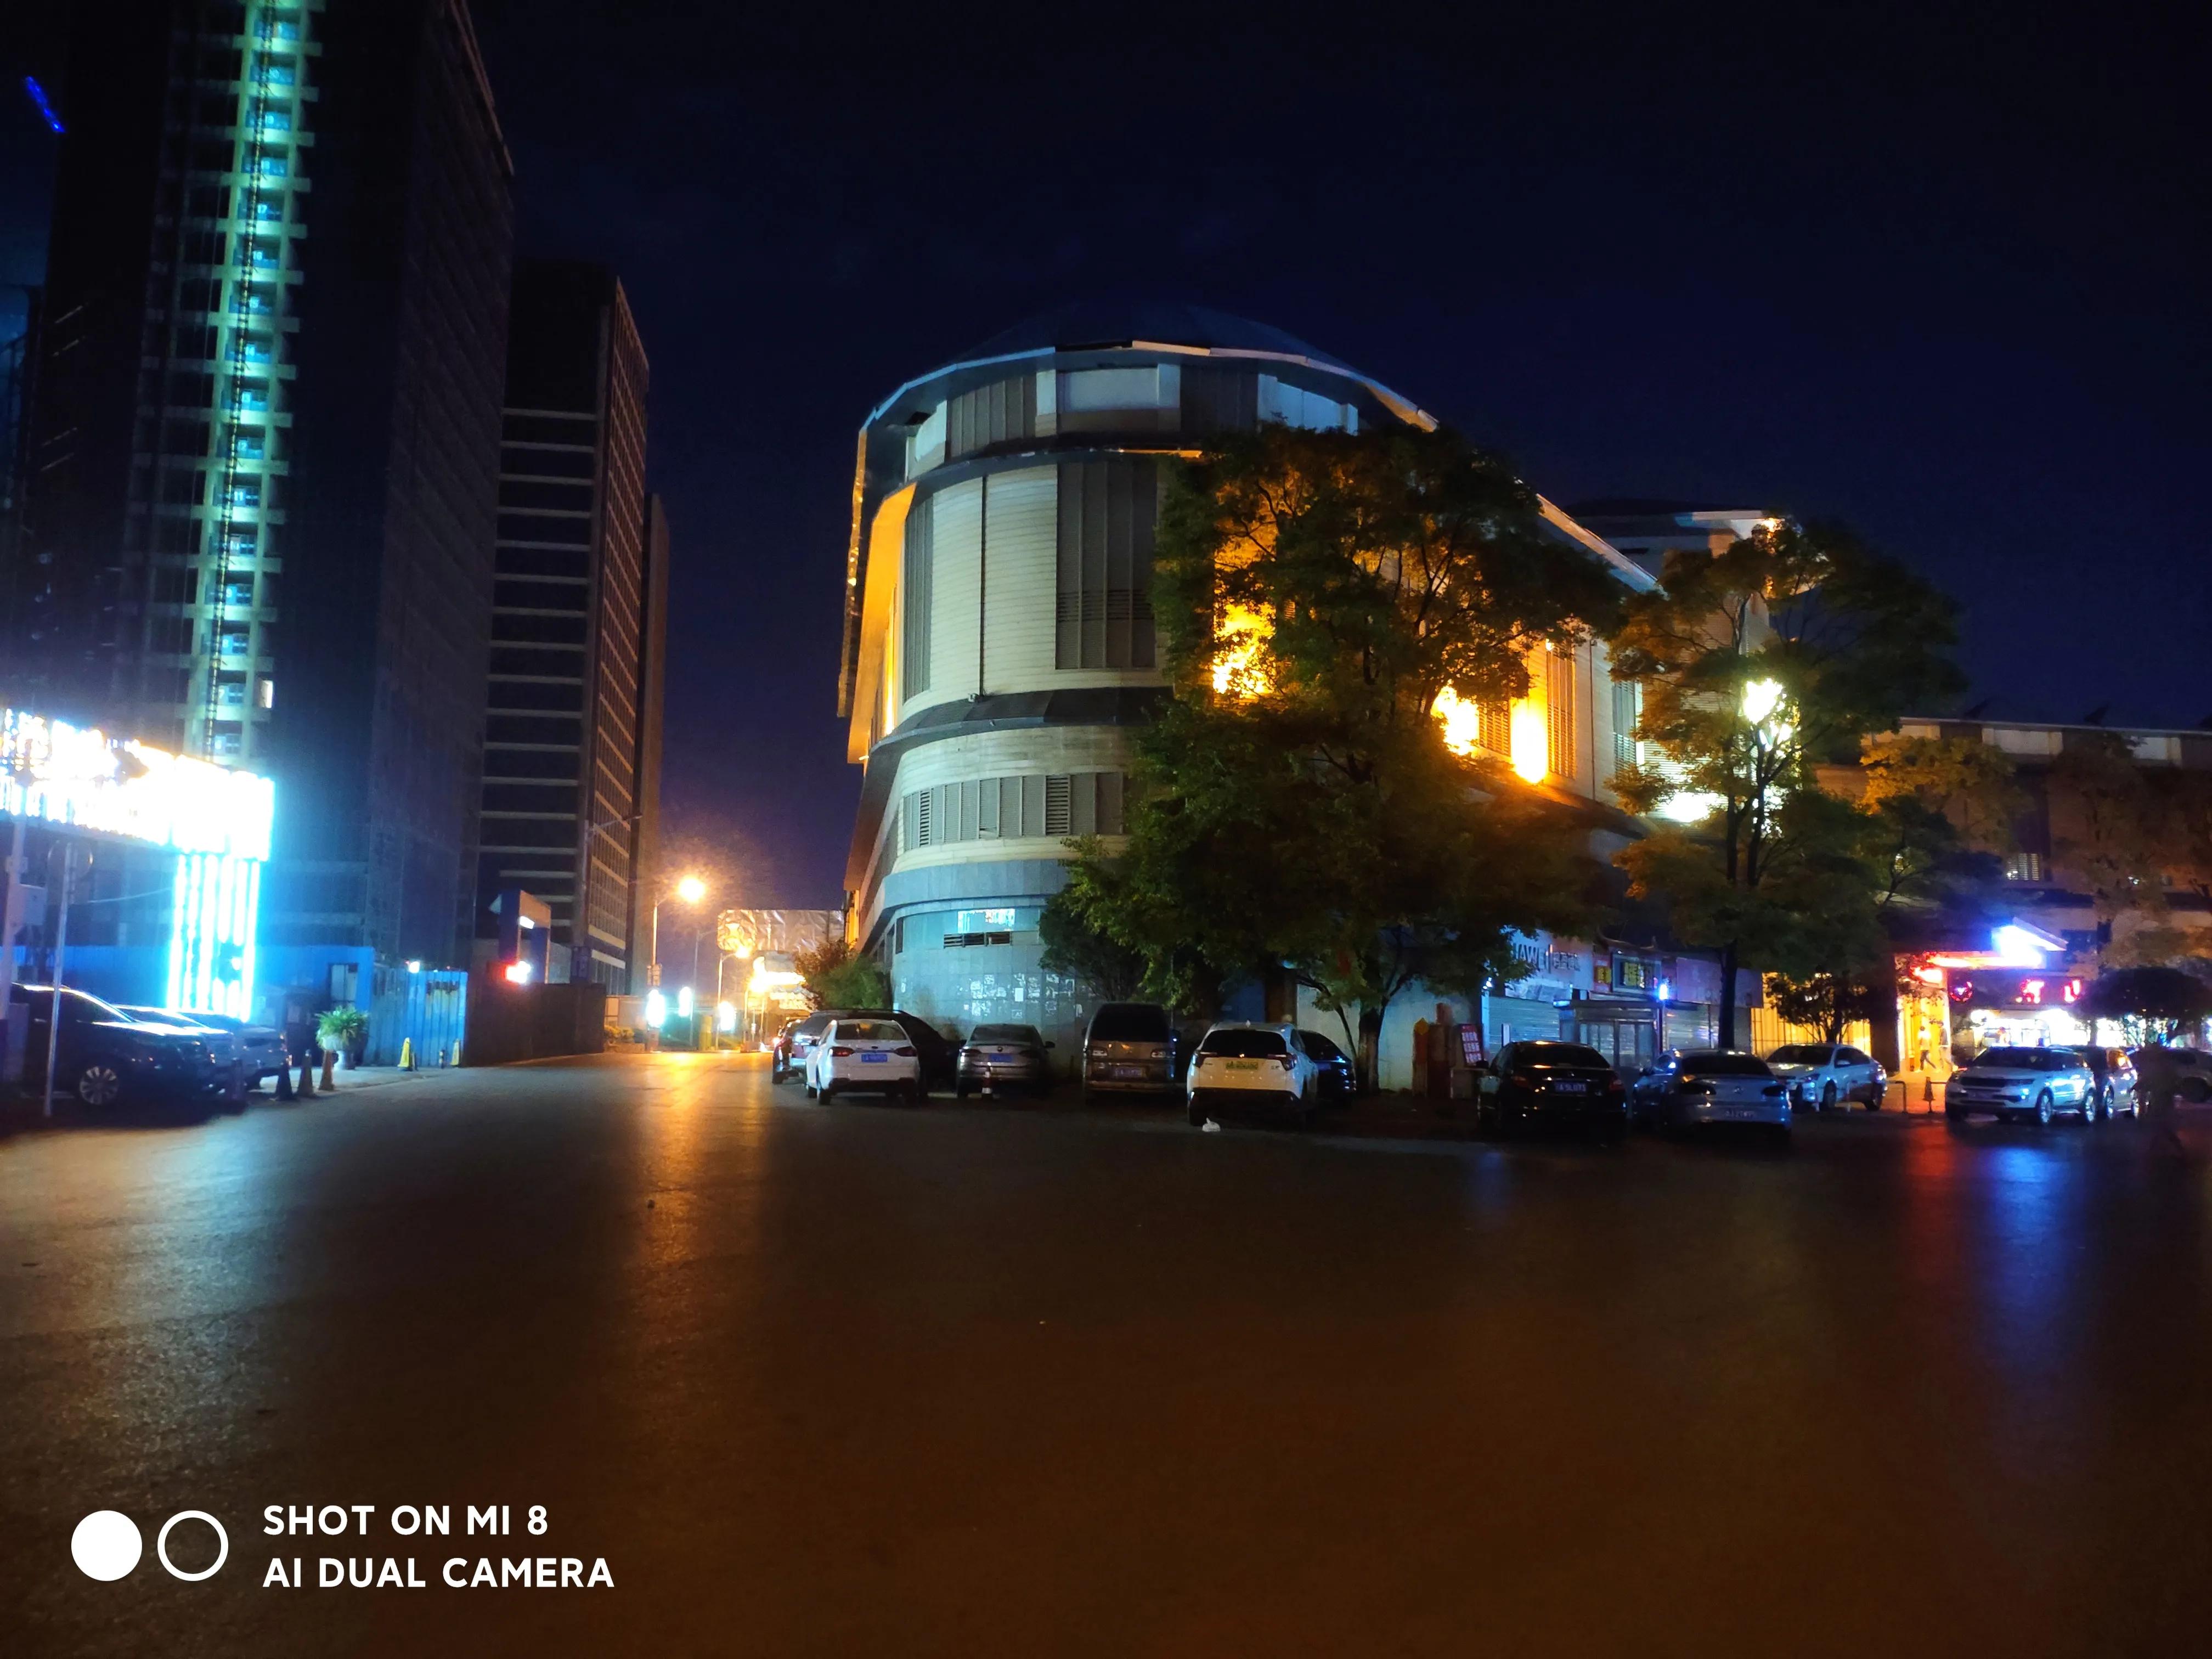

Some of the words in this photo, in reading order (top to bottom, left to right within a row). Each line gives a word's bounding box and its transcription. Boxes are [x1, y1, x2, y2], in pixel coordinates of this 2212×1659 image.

[257, 205, 268, 213] 17
[253, 251, 262, 261] 16
[234, 491, 244, 500] 11
[219, 689, 225, 699] 7
